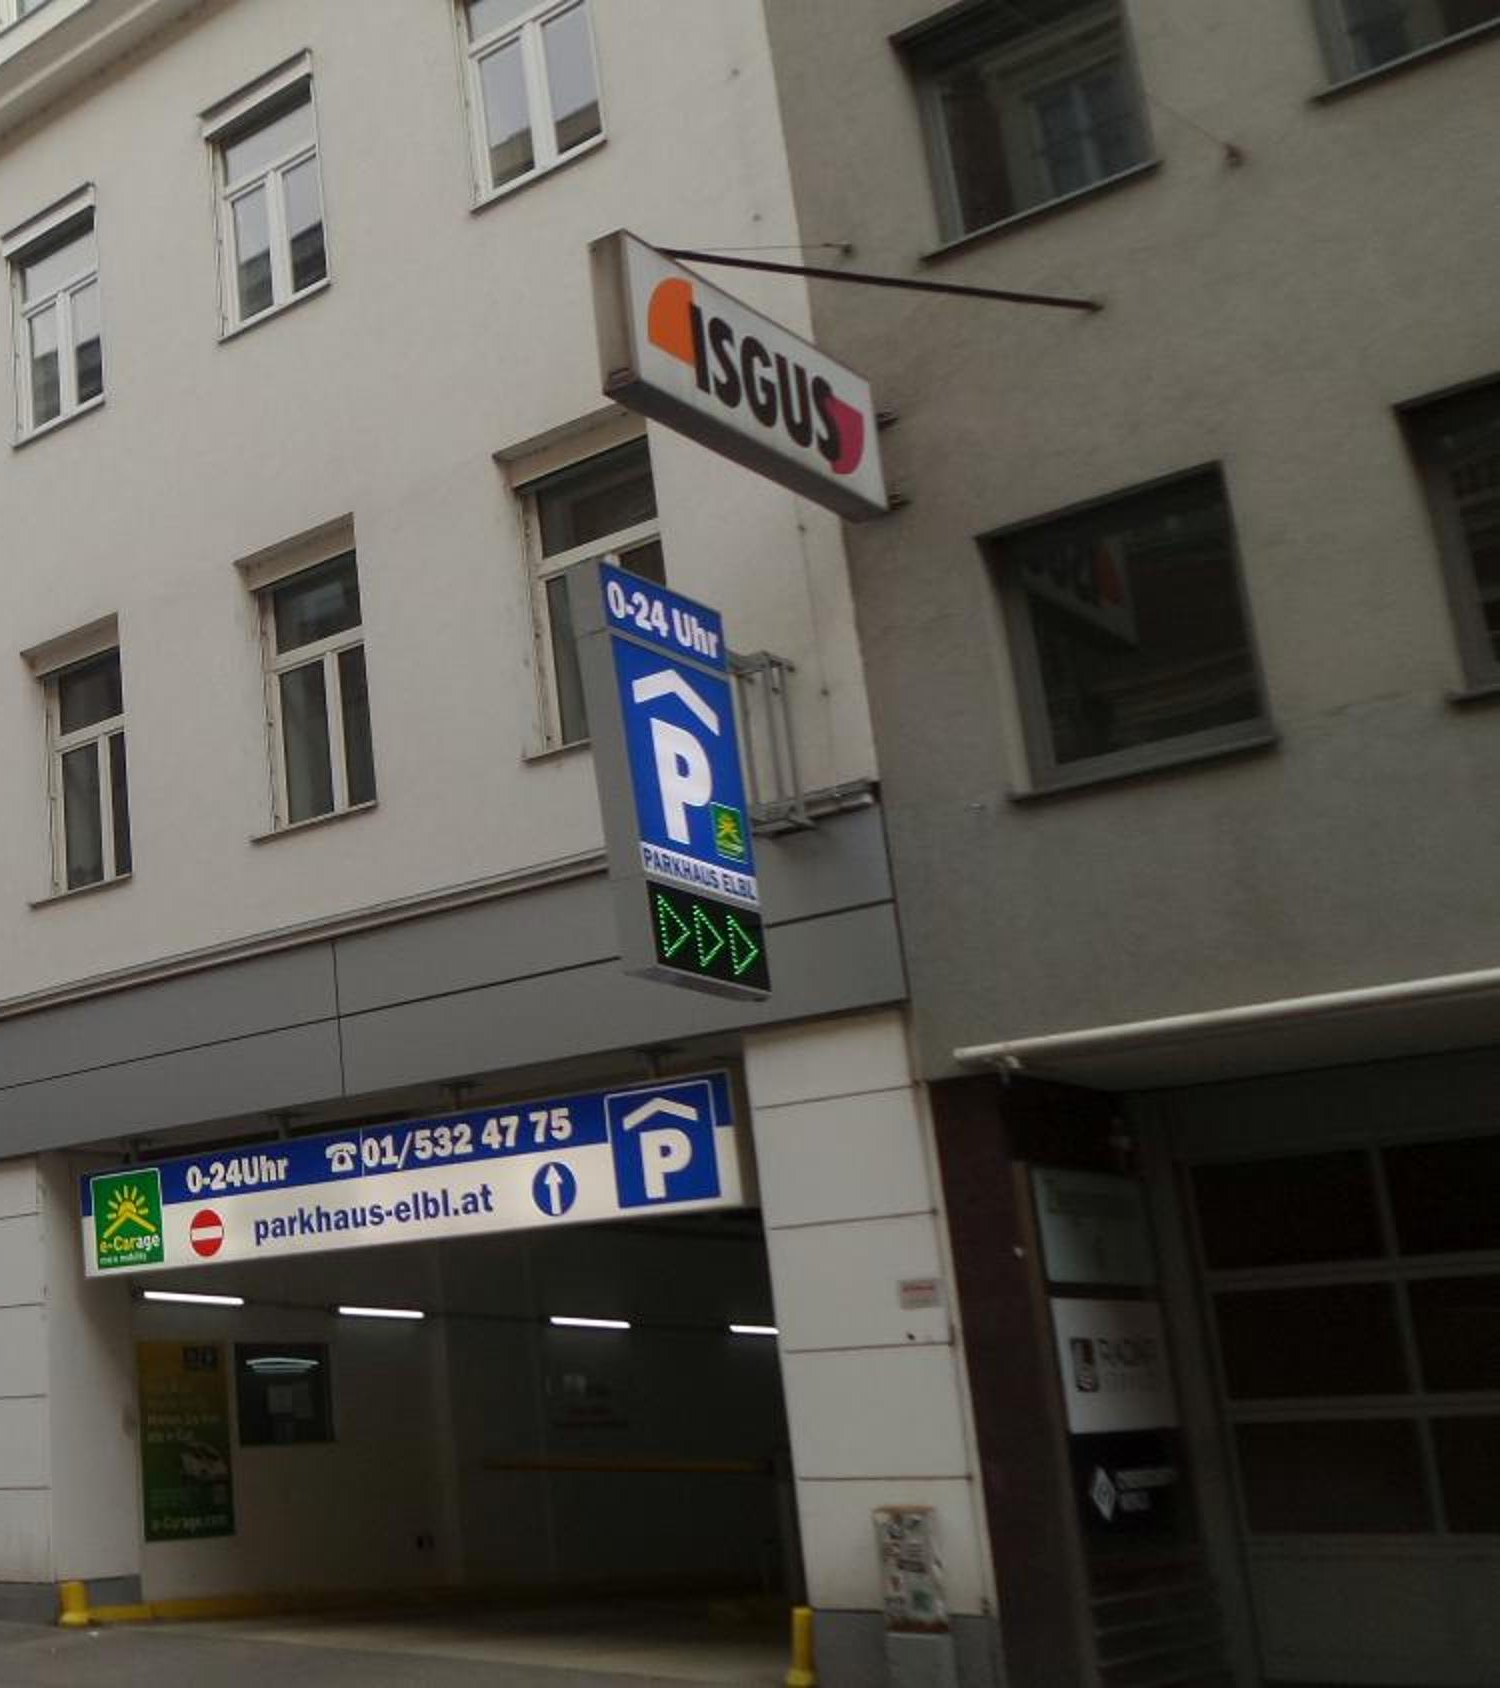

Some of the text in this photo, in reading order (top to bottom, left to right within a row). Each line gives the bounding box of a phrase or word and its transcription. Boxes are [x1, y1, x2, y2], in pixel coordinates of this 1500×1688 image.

[690, 301, 841, 463] ISGUS
[607, 580, 718, 659] 0-24 Uhr
[650, 717, 713, 845] P
[643, 847, 719, 890] PARKHAUS
[721, 872, 757, 901] ELBL
[186, 1107, 573, 1194] 0-24Uhr 01/532 47 75
[639, 1127, 693, 1199] P
[100, 1234, 160, 1254] e-Garage
[254, 1183, 494, 1246] parkhaus-elbl.at
